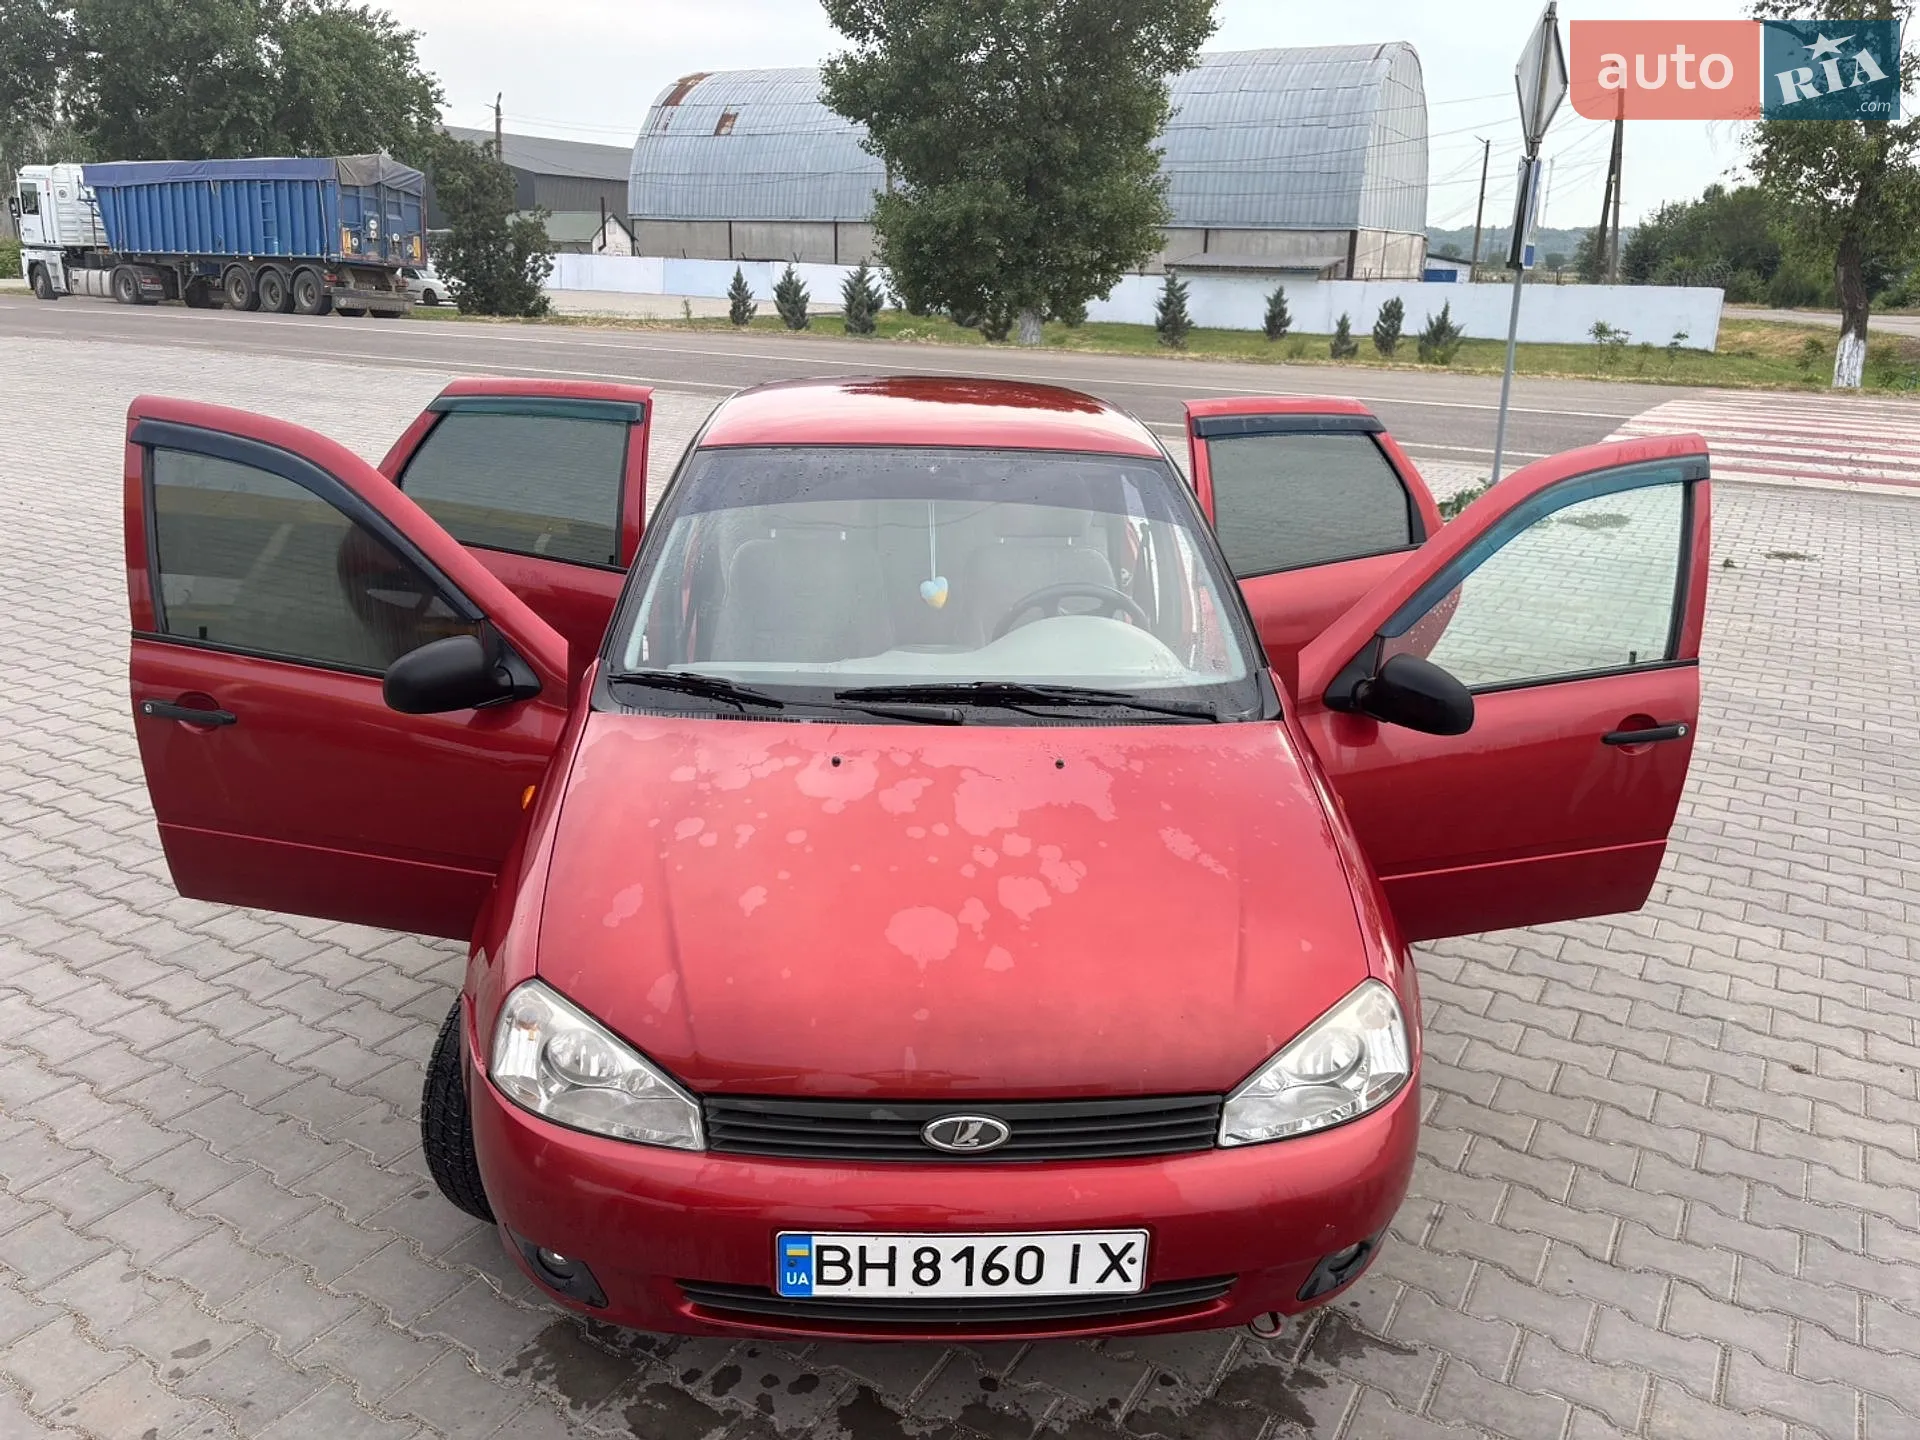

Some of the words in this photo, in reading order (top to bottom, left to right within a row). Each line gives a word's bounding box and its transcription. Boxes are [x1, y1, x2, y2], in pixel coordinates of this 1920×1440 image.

[786, 1271, 810, 1286] UA
[815, 1244, 897, 1287] BH
[911, 1244, 1045, 1287] 8160
[1068, 1241, 1136, 1285] IX
